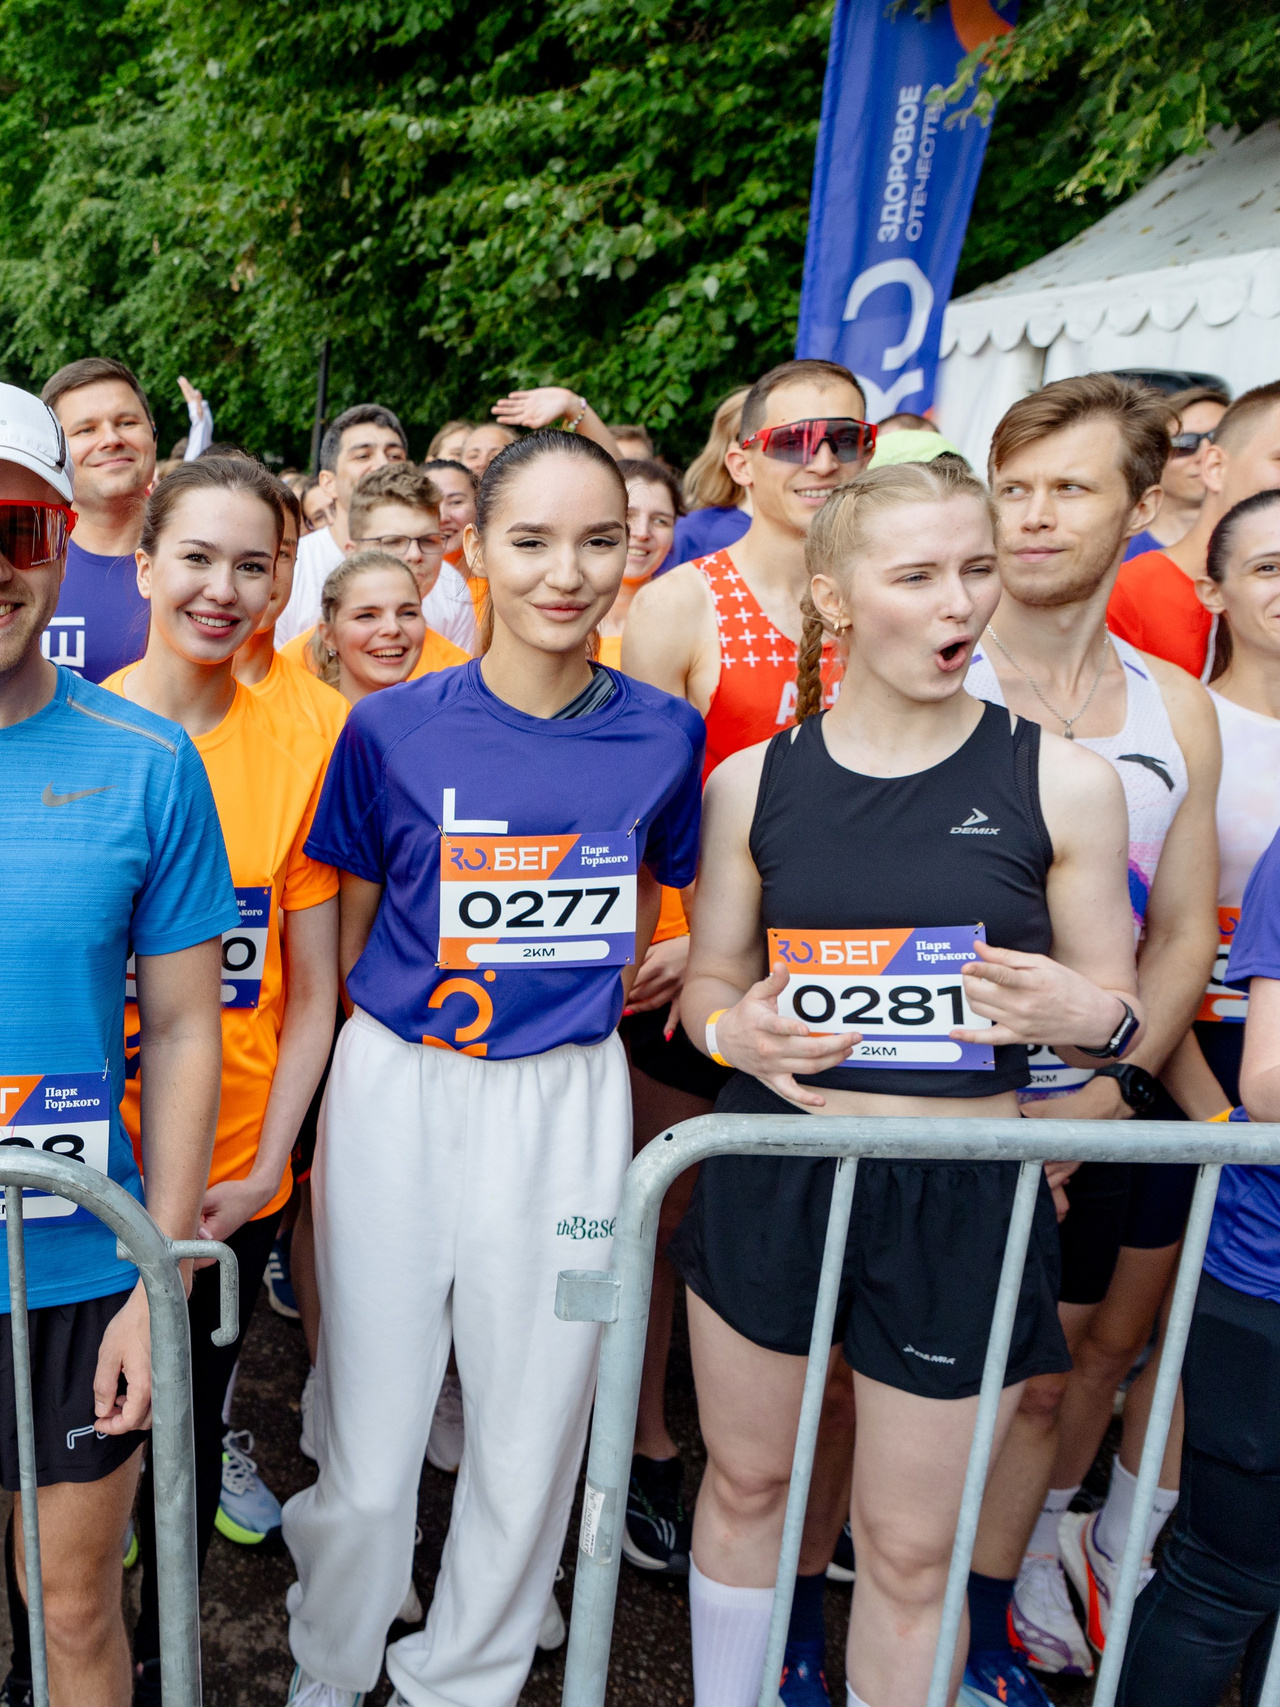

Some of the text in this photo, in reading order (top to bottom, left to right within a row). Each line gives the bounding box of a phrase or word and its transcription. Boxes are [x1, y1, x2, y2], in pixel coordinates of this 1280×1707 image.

[877, 84, 922, 243] ЗДОРОВОЕ
[949, 827, 1001, 836] DEMIX
[581, 845, 610, 856] Парк
[580, 855, 629, 867] Горького
[458, 886, 620, 930] 0277
[916, 940, 951, 952] Парк
[916, 951, 977, 964] Горького
[792, 984, 965, 1026] 0281
[45, 1087, 78, 1099] Парк
[44, 1098, 101, 1112] Горького
